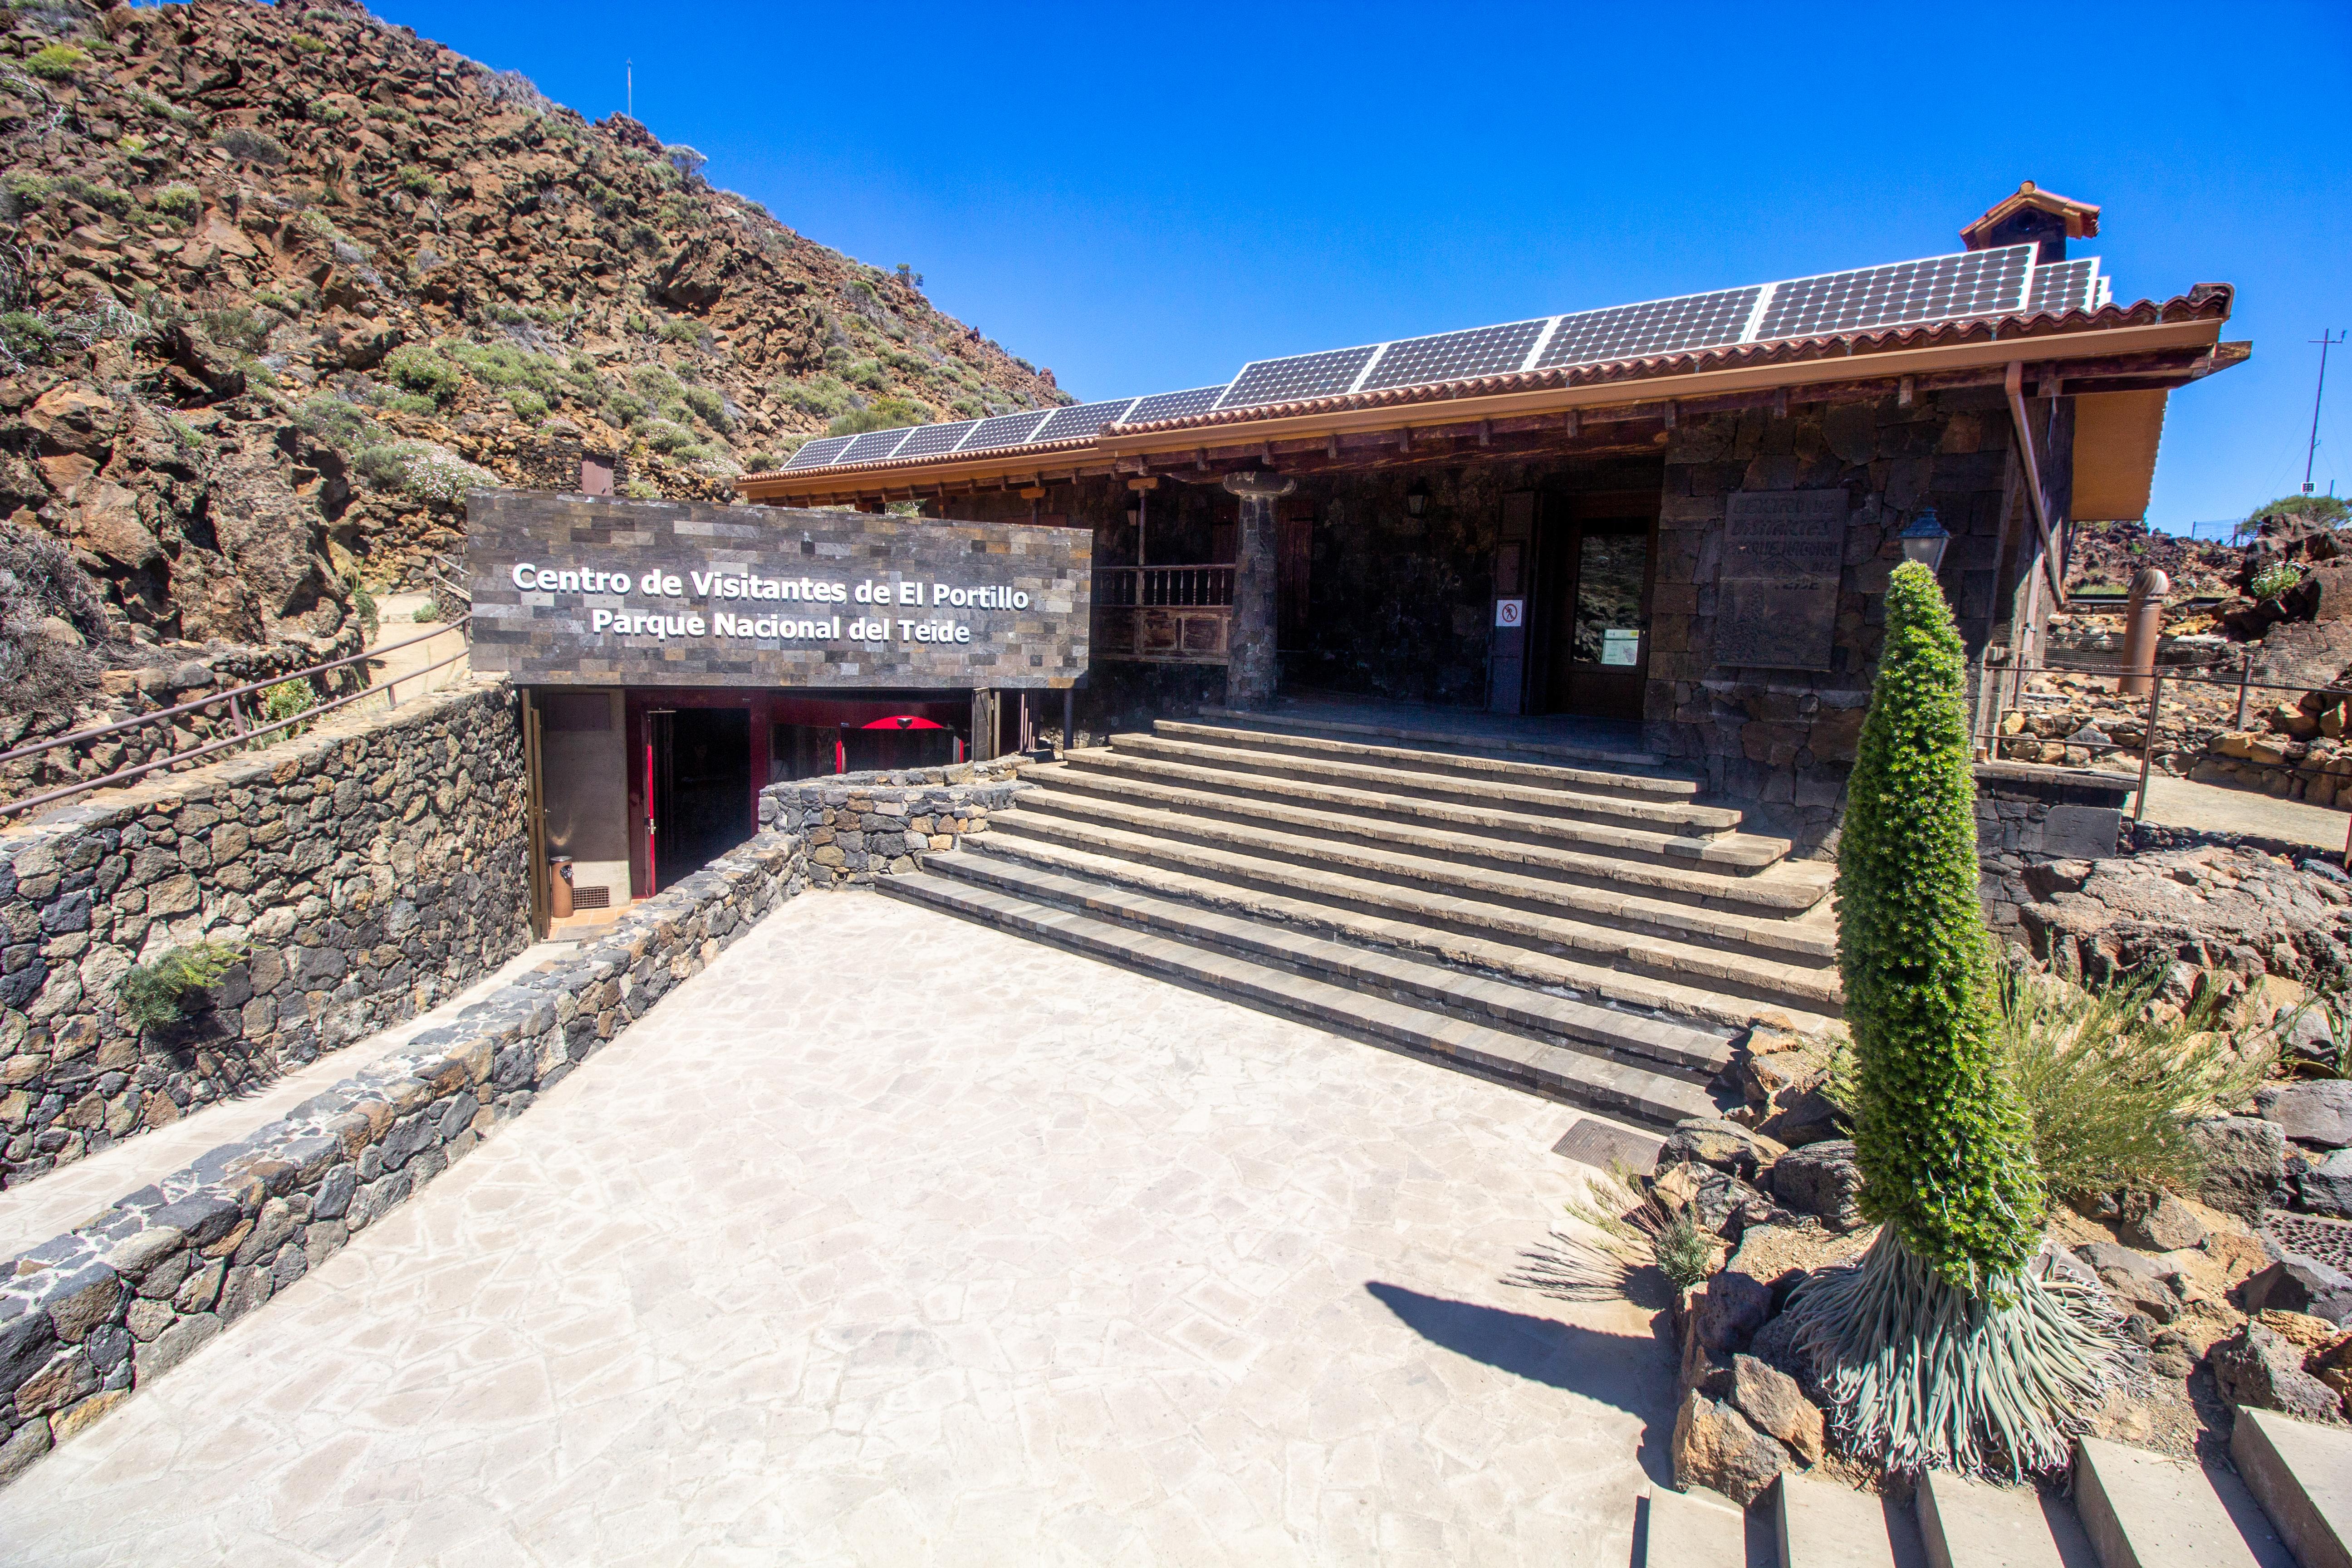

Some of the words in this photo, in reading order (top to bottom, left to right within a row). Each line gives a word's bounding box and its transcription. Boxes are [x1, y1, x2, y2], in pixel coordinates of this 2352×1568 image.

[512, 563, 631, 593] Centro
[641, 568, 683, 596] de
[690, 571, 847, 603] Visitantes
[854, 579, 891, 605] de
[899, 581, 924, 606] El
[932, 583, 1029, 609] Portillo
[592, 609, 706, 640] Parque
[714, 612, 841, 639] Nacional
[848, 617, 891, 641] del
[897, 619, 970, 643] Teide
